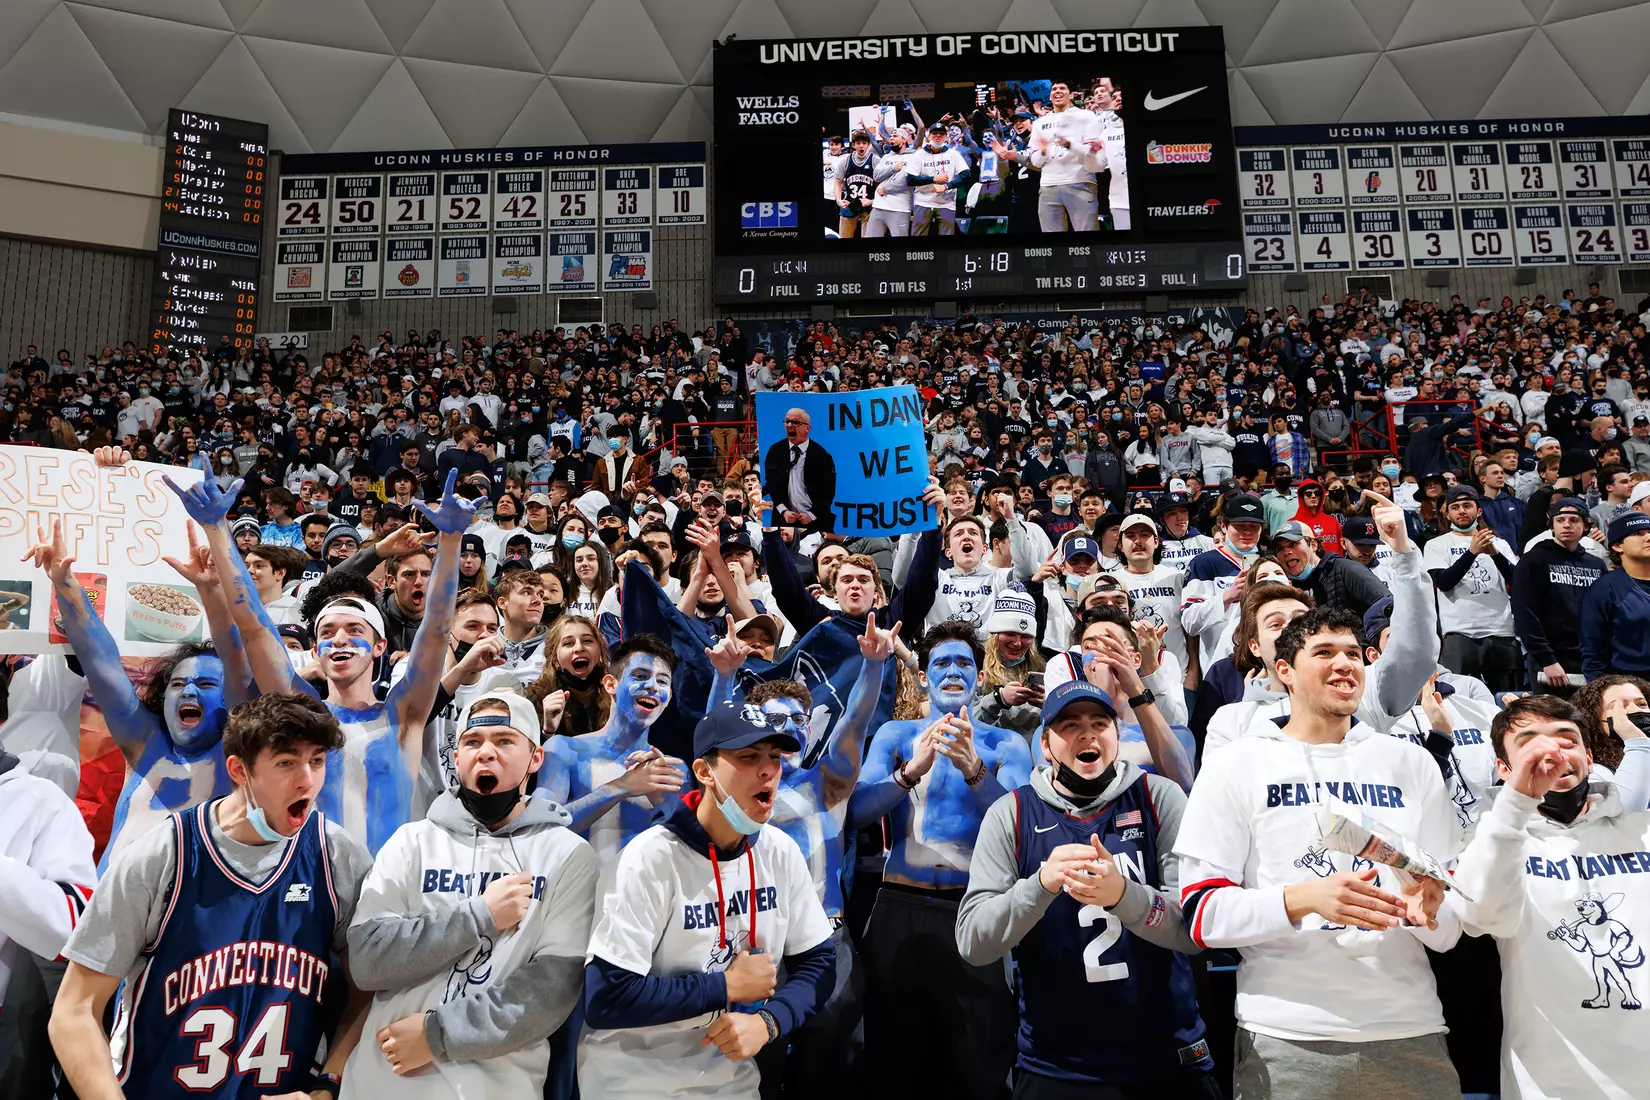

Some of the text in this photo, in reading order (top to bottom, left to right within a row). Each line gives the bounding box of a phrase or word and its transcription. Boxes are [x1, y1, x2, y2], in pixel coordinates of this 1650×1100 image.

[760, 32, 1180, 64] UNIVERSITY OF CONNECTICUT
[736, 95, 800, 109] WELLS
[738, 111, 800, 125] FARGO
[1328, 122, 1565, 137] UCONN HUSKIES OF HONOR
[1164, 144, 1212, 153] DUNKIN'
[1413, 147, 1433, 156] RENEE
[1468, 146, 1484, 154] TINA
[1567, 143, 1597, 151] STEFANIE
[374, 149, 610, 165] UCONN HUSKIES OF HONOR
[1165, 152, 1210, 162] DONUTS
[1254, 151, 1271, 160] SWIN
[1402, 156, 1446, 166] MONTGOMERY
[1462, 155, 1491, 164] CHARLES
[1519, 153, 1540, 163] MOORE
[1570, 152, 1597, 162] DOLSON
[1254, 161, 1272, 170] CASH
[1301, 159, 1332, 169] TAURASI
[1352, 157, 1389, 168] AURIEMMA
[620, 170, 636, 179] SHEA
[675, 168, 687, 177] SUE
[1521, 166, 1544, 189] 23
[1574, 164, 1597, 188] 31
[1627, 163, 1650, 186] 14
[397, 176, 428, 185] JENNIFER
[552, 180, 595, 190] ABROSIMOVA
[673, 178, 690, 187] BIRD
[1254, 173, 1275, 196] 32
[1313, 172, 1324, 195] 3
[1416, 169, 1437, 192] 20
[1469, 167, 1490, 191] 31
[450, 184, 482, 194] WOLTERS
[509, 182, 531, 192] SALES
[849, 184, 868, 199] 34
[502, 195, 537, 218] 42
[560, 194, 586, 216] 25
[617, 192, 638, 215] 33
[672, 190, 690, 213] 10
[285, 202, 321, 225] 24
[339, 200, 374, 223] 50
[397, 198, 425, 222] 21
[449, 196, 481, 220] 52
[742, 202, 793, 218] CBS
[1146, 205, 1209, 216] TRAVELERS
[1631, 205, 1648, 214] KATIE
[1361, 221, 1393, 231] STEWART
[1423, 220, 1441, 230] TUCK
[1473, 219, 1497, 228] DAILEY
[1521, 217, 1556, 227] WILLIAMS
[1581, 216, 1604, 226] COLLIER
[768, 230, 798, 238] Company
[1304, 223, 1342, 233] JEFFERSON
[448, 239, 479, 248] NATIONAL
[502, 237, 533, 245] NATIONAL
[559, 234, 586, 244] NATIONAL
[614, 233, 641, 242] NATIONAL
[1528, 230, 1553, 254] 15
[1576, 229, 1615, 252] 24
[286, 244, 316, 253] NATIONAL
[340, 242, 370, 251] NATIONAL
[395, 240, 425, 249] NATIONAL
[557, 244, 587, 254] CHAMPION
[613, 243, 642, 252] CHAMPION
[1253, 237, 1285, 262] 23
[1317, 236, 1332, 259] 4
[1363, 234, 1394, 258] 30
[1425, 232, 1442, 257] 3
[1471, 232, 1502, 256] CD
[337, 252, 373, 262] CHAMPION
[392, 250, 428, 260] CHAMPION
[446, 248, 481, 258] CHAMPION
[500, 246, 536, 256] CHAMPION
[868, 252, 890, 262] POSS
[906, 252, 934, 261] BONUS
[1024, 248, 1053, 258] BONUS
[1068, 246, 1090, 256] POSS
[283, 253, 319, 263] CHAMPION
[964, 252, 1009, 272] 6:18
[1226, 254, 1242, 280] 0
[738, 268, 755, 293] 0
[1035, 276, 1086, 289] TM FLS 0
[1100, 274, 1146, 287] 30 SEC 3
[1161, 274, 1186, 286] FULL
[776, 284, 800, 296] FULL
[816, 282, 862, 296] 3 30 SEC
[879, 281, 926, 294] 0 TM FLS
[1000, 320, 1022, 329] arry
[280, 334, 307, 346] 201
[828, 394, 920, 430] IN DAN
[859, 444, 913, 478] WE
[0, 450, 169, 518] RESE'S
[834, 495, 929, 529] TRUST
[0, 508, 163, 566] PUFFS
[1177, 548, 1203, 558] XAVIER
[1549, 564, 1592, 574] UNIVERSITY
[942, 584, 993, 599] BEAT XAVIER
[1141, 587, 1176, 598] XAVIER
[996, 600, 1020, 610] UCONN
[132, 609, 188, 632] Rese's Puffs
[1266, 781, 1405, 808] BEAT XAVIER
[1576, 851, 1650, 880] XAVIER
[422, 869, 548, 902] BEAT XAER
[725, 886, 777, 921] AVER
[1077, 904, 1130, 984] 2
[163, 940, 330, 1017] CONNECTICUT
[174, 1002, 292, 1092] 34
